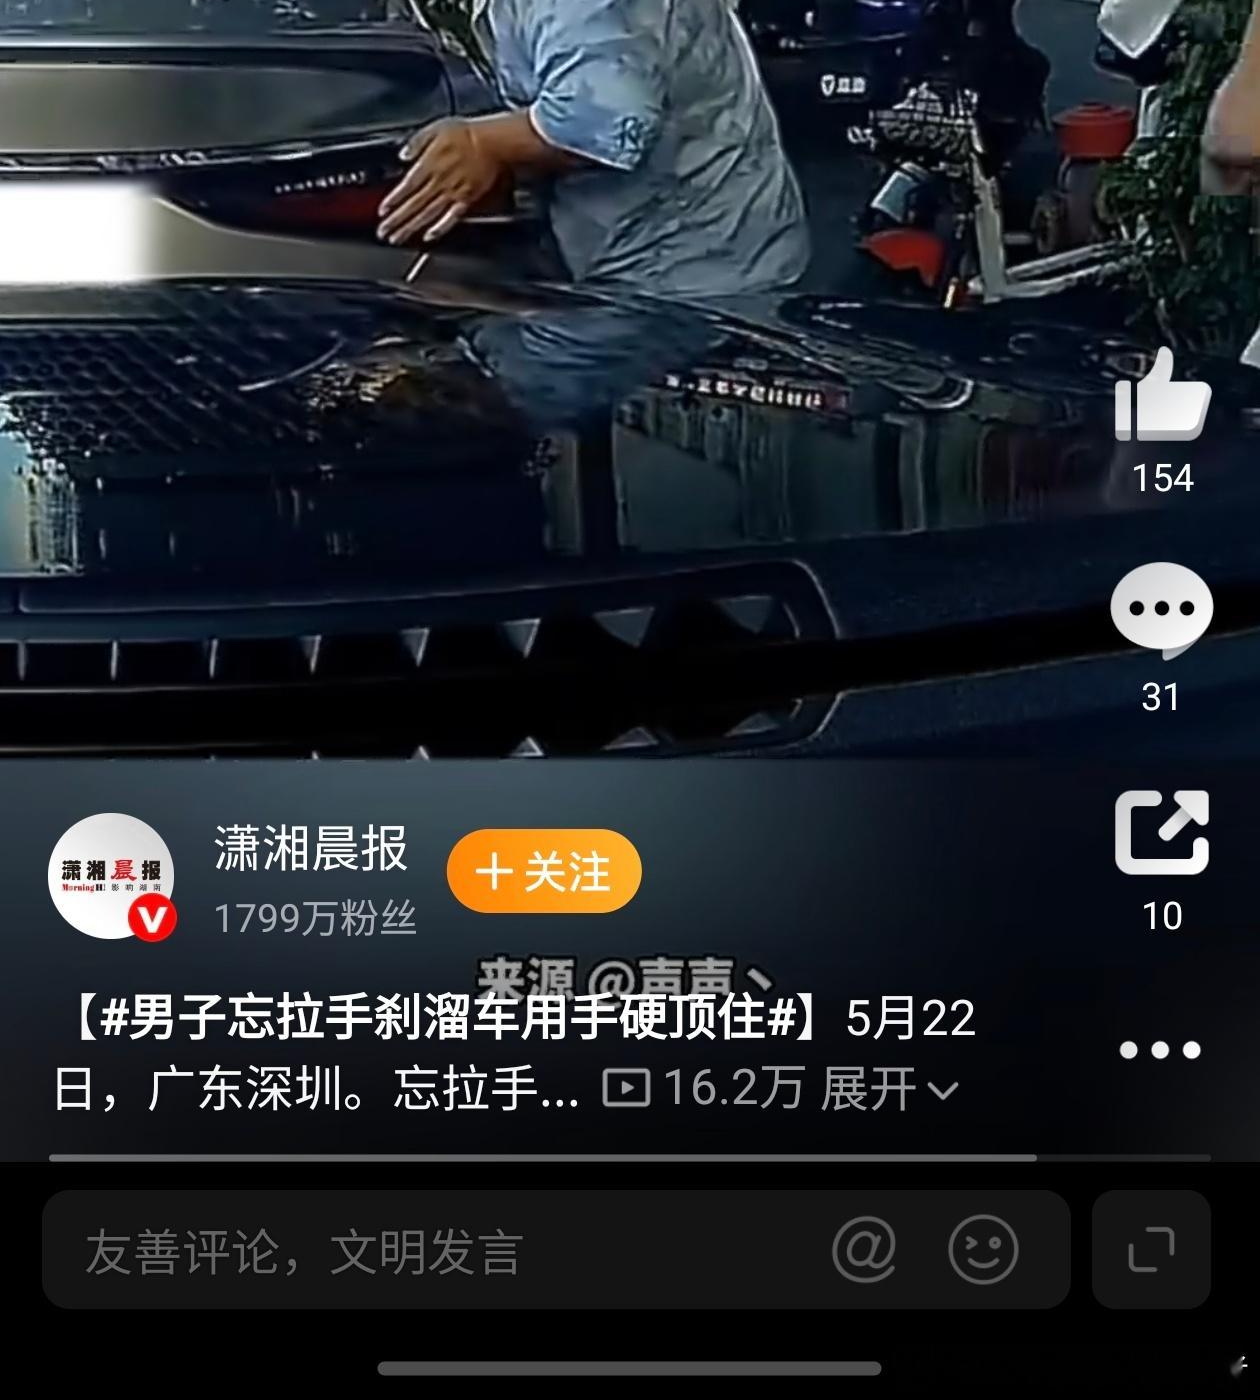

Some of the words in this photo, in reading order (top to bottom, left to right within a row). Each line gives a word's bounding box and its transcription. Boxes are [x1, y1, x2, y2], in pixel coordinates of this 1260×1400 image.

[1134, 464, 1194, 491] 154
[1143, 683, 1177, 710] 31
[215, 824, 407, 872] 潇湘晨报
[62, 860, 161, 881] 潇湘晨报
[137, 906, 168, 933] V
[216, 899, 416, 937] 1799万粉丝
[1144, 902, 1182, 929] 10
[666, 1066, 806, 1109] 16.2万
[822, 1067, 917, 1111] 展开
[85, 1227, 524, 1276] 友善评论，文明发言
